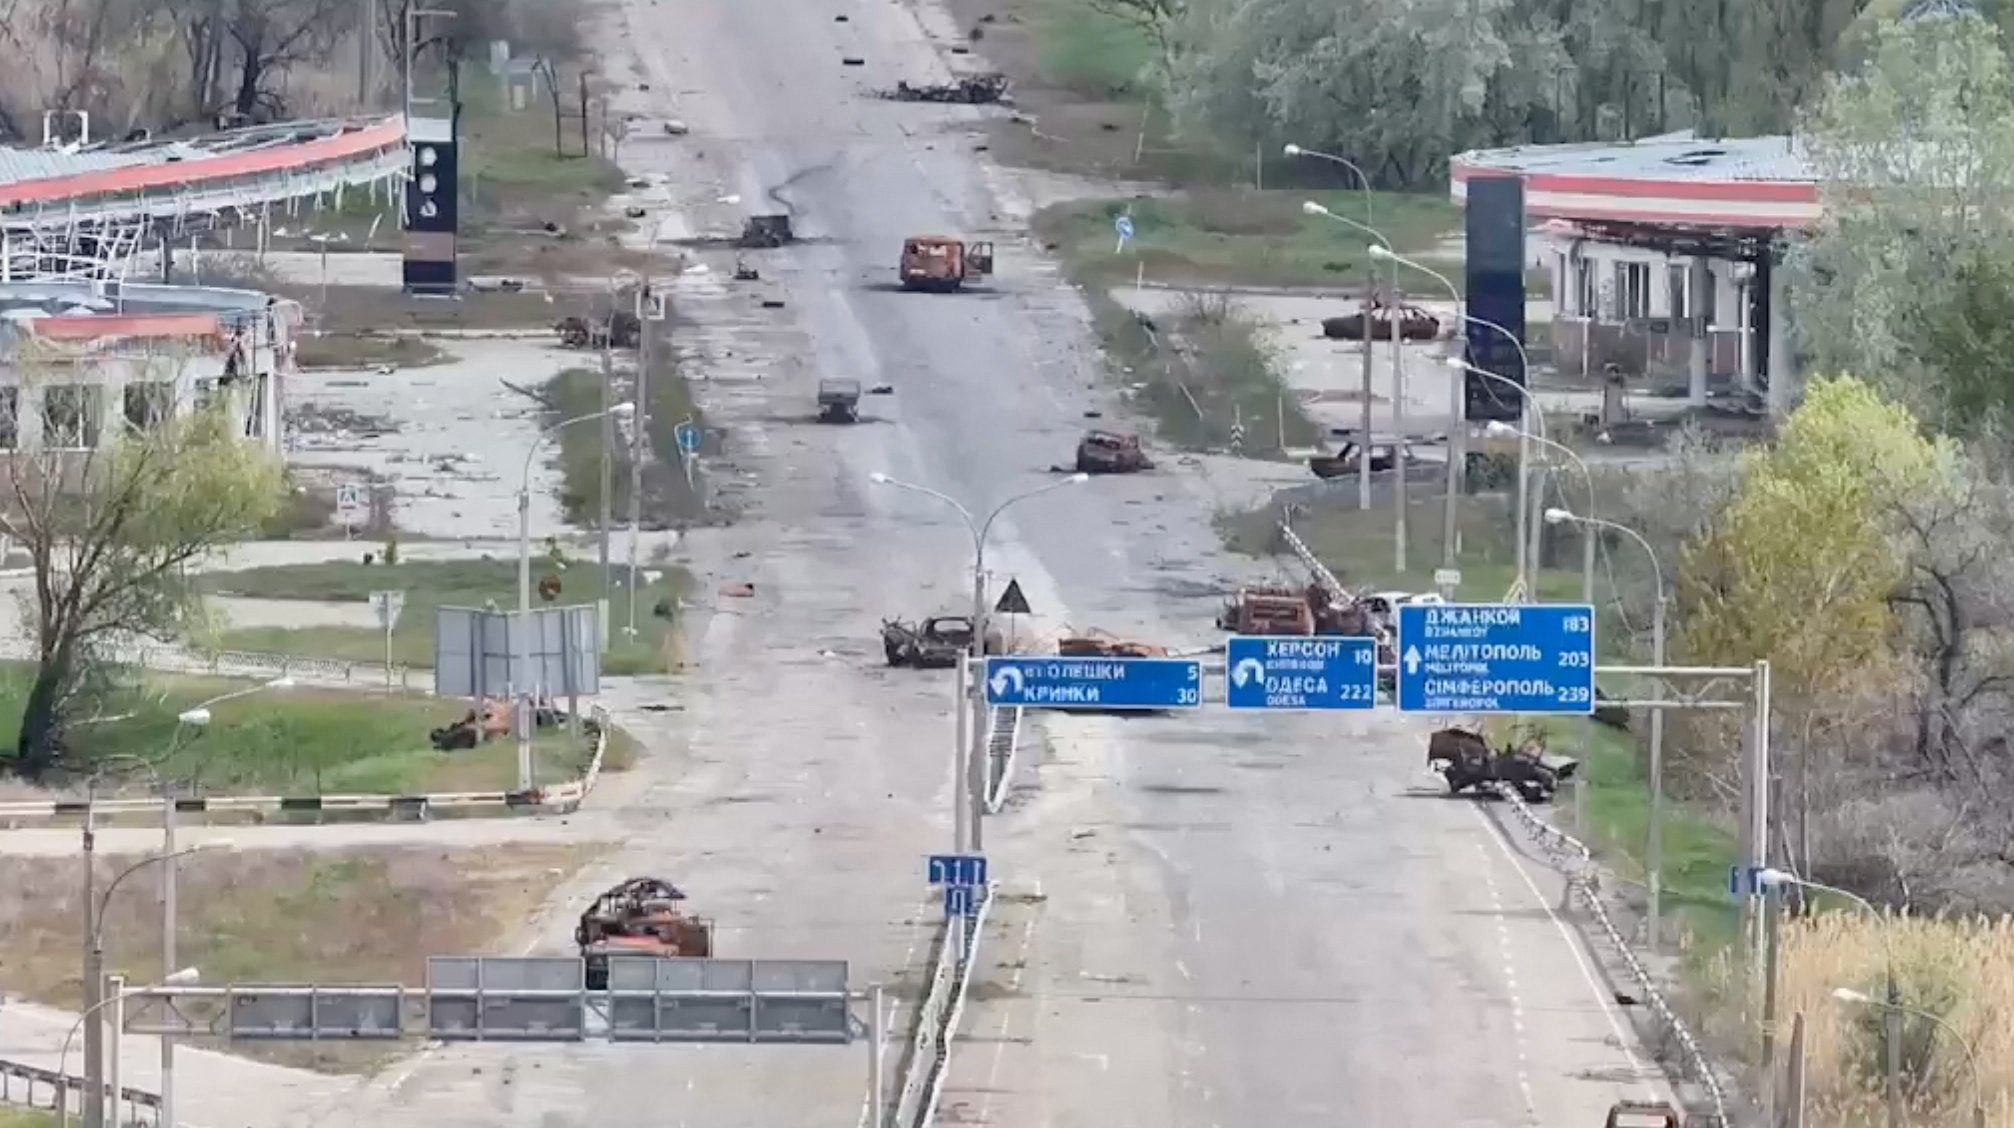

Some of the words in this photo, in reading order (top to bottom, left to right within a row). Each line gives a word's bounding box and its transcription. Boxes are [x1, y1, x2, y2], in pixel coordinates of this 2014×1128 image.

[1425, 609, 1520, 625] ДЖАНКОЙ
[1563, 616, 1589, 632] 183
[1266, 642, 1341, 657] ХЕРСОН
[1354, 649, 1372, 665] 10
[1425, 644, 1542, 660] МЕЛІТОПОЛЬ
[1558, 652, 1589, 667] 203
[1047, 663, 1125, 679] ОЛЕШКИ
[1187, 665, 1198, 681] 5
[1024, 685, 1100, 701] КРИНКИ
[1176, 688, 1197, 704] 30
[1266, 676, 1328, 693] ОДЕСА
[1340, 684, 1372, 700] 222
[1425, 679, 1555, 695] СІМФЕРОПОЛЬ
[1558, 687, 1589, 702] 239
